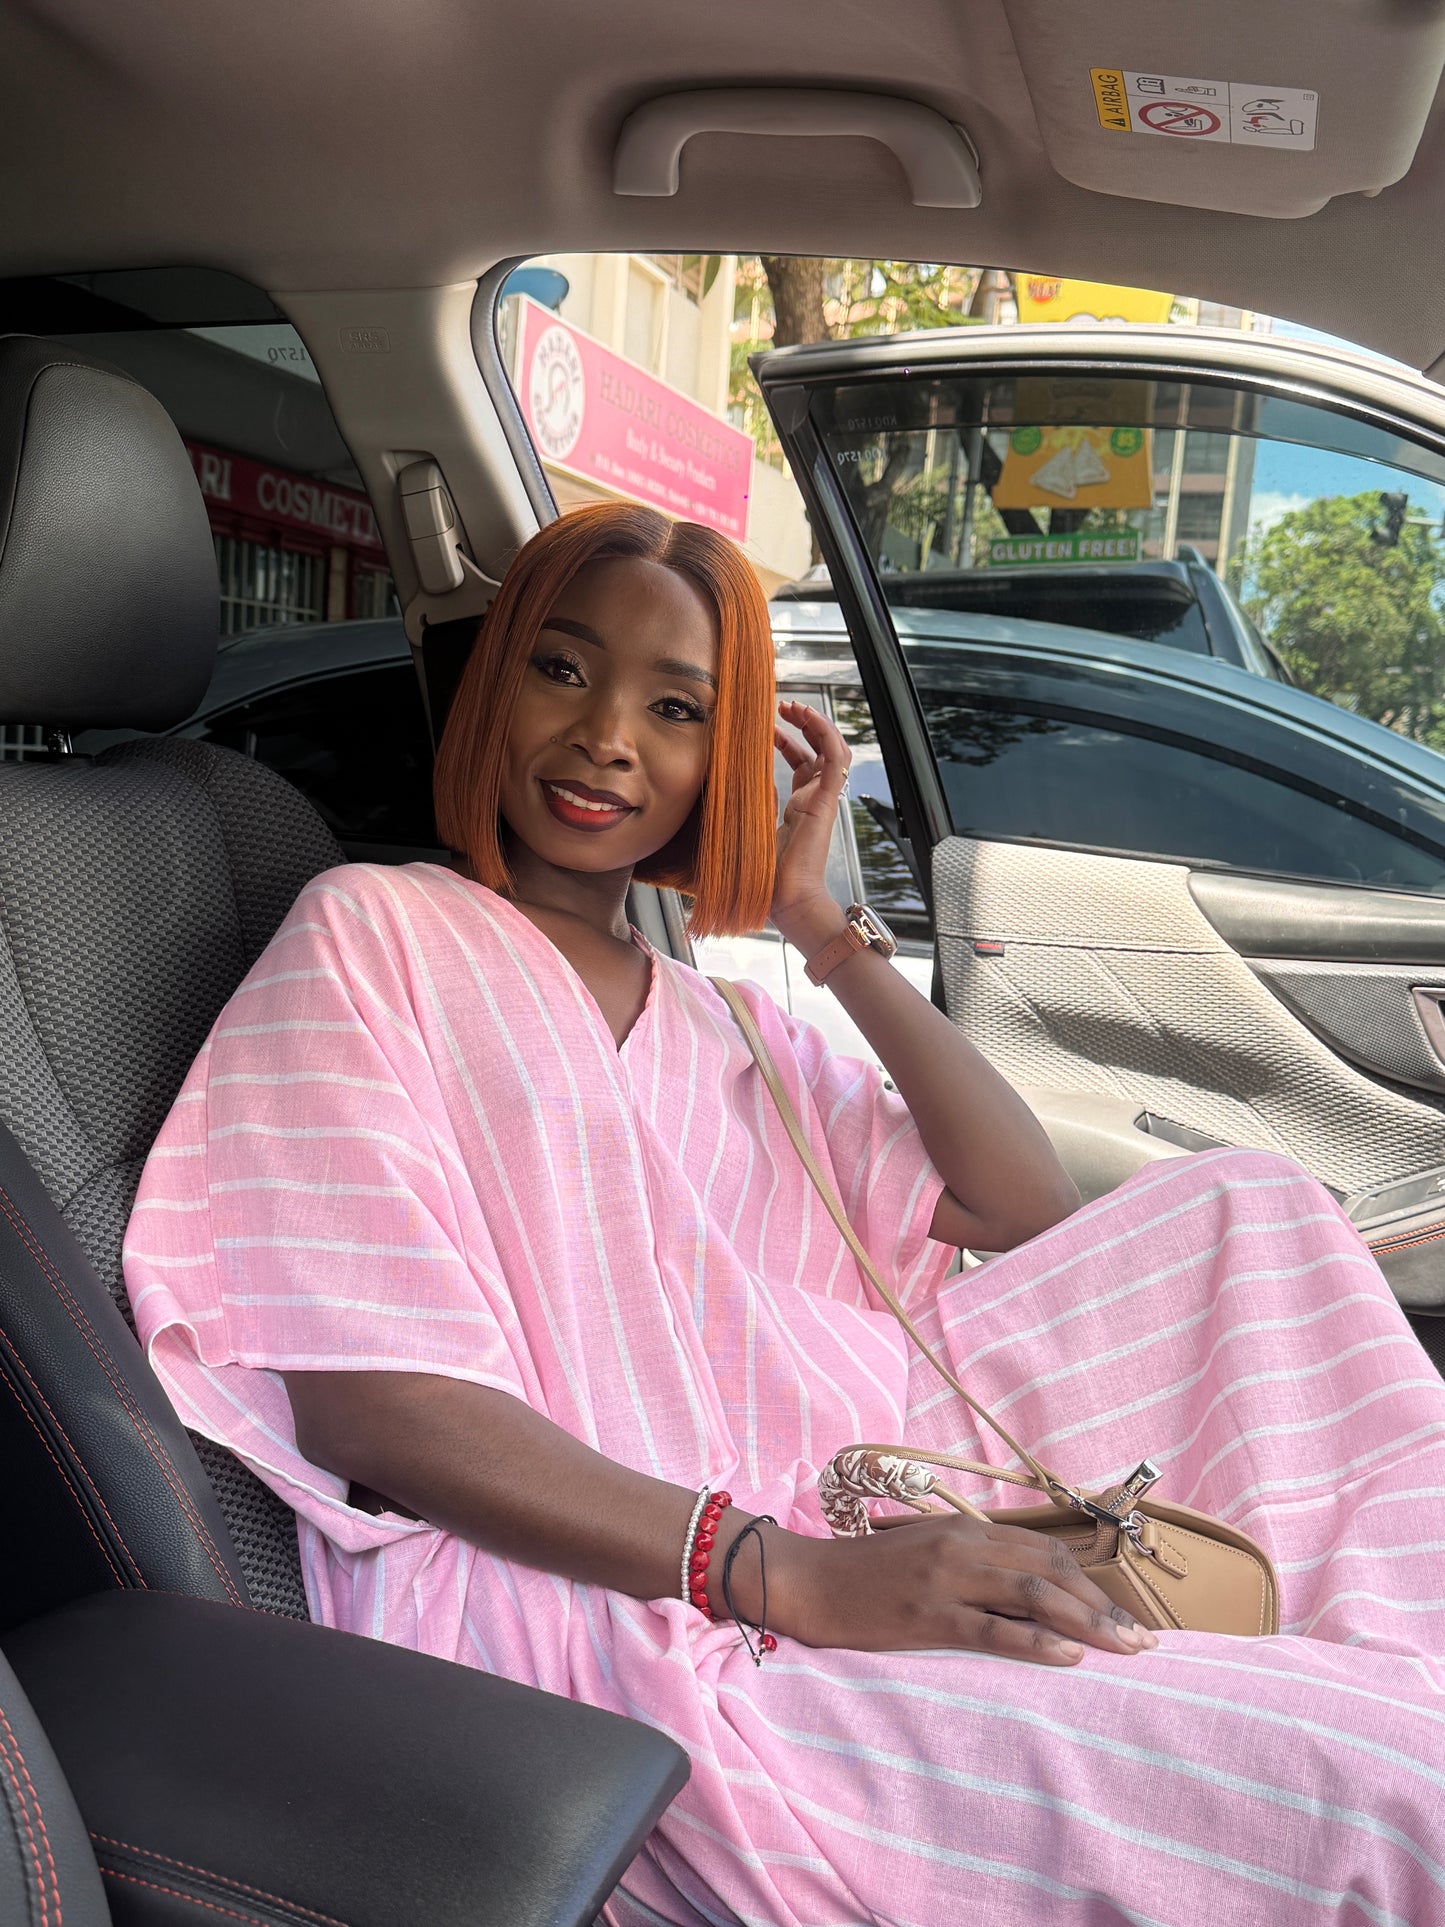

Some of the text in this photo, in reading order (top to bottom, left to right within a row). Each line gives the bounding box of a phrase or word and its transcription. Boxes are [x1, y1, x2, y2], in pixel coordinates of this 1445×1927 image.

[1098, 74, 1124, 116] AIRBAG
[599, 370, 741, 476] HADARI COSMETICS
[190, 449, 376, 541] RI COSMETI
[991, 537, 1136, 561] GLUTEN FREE!
